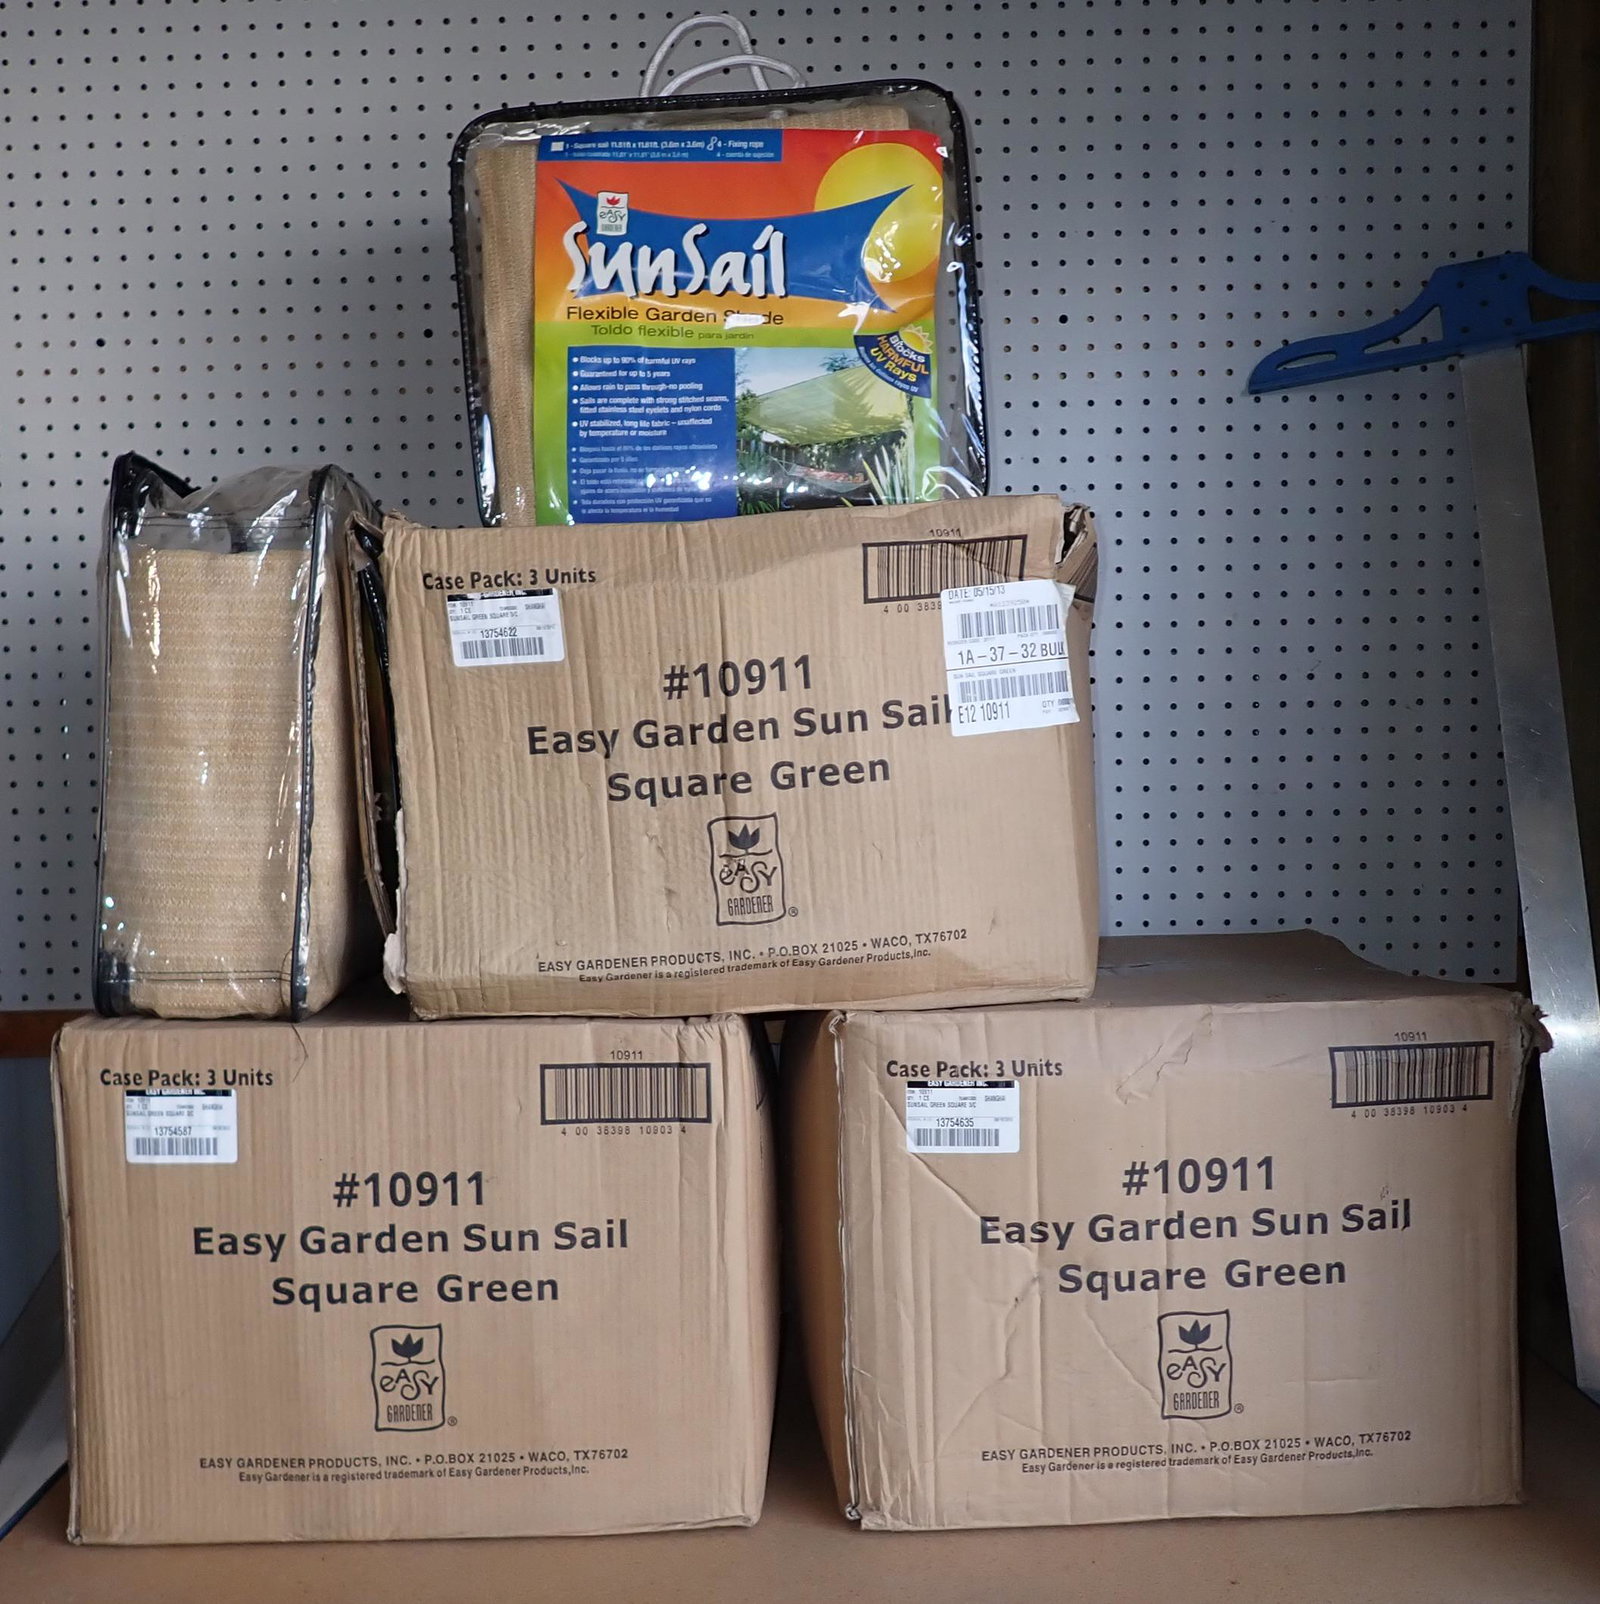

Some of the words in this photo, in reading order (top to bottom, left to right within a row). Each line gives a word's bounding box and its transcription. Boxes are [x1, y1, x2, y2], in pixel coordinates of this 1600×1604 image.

[566, 306, 639, 320] Flexible
[646, 307, 717, 323] Garden
[724, 309, 784, 325] Sde
[591, 324, 633, 336] Toldo
[638, 325, 694, 338] flexible
[877, 335, 929, 374] HARMFUL
[889, 335, 925, 363] Blocks
[870, 347, 888, 362] UV
[884, 360, 917, 382] Rays
[929, 528, 962, 538] 10911
[423, 572, 464, 590] Case
[470, 570, 523, 589] Pack:
[529, 569, 538, 586] 3
[545, 568, 596, 584] Units
[948, 590, 970, 600] DATE:
[973, 586, 1005, 597] 05/15/13
[480, 627, 518, 638] 13754622
[990, 646, 1005, 662] 37
[1021, 642, 1036, 658] 32
[663, 654, 812, 700] #10911
[958, 704, 976, 724] E12
[980, 701, 1010, 721] 10911
[527, 725, 619, 758] Easy
[634, 713, 779, 749] Garden
[794, 707, 868, 738] Sun
[882, 694, 952, 730] Sail
[607, 770, 752, 807] Square
[771, 757, 891, 790] Green
[727, 895, 773, 916] GARDENER
[538, 960, 572, 973] EASY
[577, 956, 648, 971] GARDENER
[651, 951, 725, 967] PRODUCTS,
[729, 949, 755, 961] INC.
[768, 944, 818, 958] P.O.BOX
[822, 940, 858, 953] 21025
[871, 935, 912, 949] WACO,
[916, 929, 967, 944] TX76702
[579, 974, 603, 983] Easy
[606, 971, 653, 981] Gardener
[655, 970, 663, 979] is
[674, 966, 725, 979] registered
[727, 958, 778, 970] trademark
[780, 959, 790, 967] of
[792, 958, 816, 968] Easy
[818, 955, 864, 967] Gardener
[1394, 1032, 1427, 1041] 10911
[610, 1050, 643, 1060] 10911
[100, 1069, 142, 1086] Case
[149, 1069, 199, 1086] Pack:
[208, 1069, 216, 1085] 3
[224, 1069, 273, 1086] Units
[886, 1060, 930, 1077] Case
[936, 1061, 988, 1078] Pack:
[996, 1061, 1004, 1077] 3
[1012, 1059, 1062, 1076] Units
[936, 1117, 974, 1127] 13754635
[1351, 1111, 1356, 1119] 4
[1364, 1109, 1376, 1117] 00
[1384, 1106, 1415, 1116] 38398
[1424, 1105, 1455, 1114] 10903
[1462, 1104, 1467, 1112] 4
[154, 1126, 192, 1136] 13754587
[561, 1128, 566, 1136] 4
[576, 1127, 588, 1136] 00
[597, 1126, 631, 1135] 38398
[681, 1125, 686, 1133] 4
[1122, 1155, 1274, 1196] #10911
[333, 1171, 485, 1208] #10911
[980, 1215, 1074, 1250] Easy
[1088, 1211, 1237, 1243] Garden
[1252, 1207, 1328, 1236] Sun
[1342, 1198, 1411, 1233] Sail
[193, 1226, 287, 1262] Easy
[300, 1224, 449, 1255] Garden
[464, 1223, 539, 1253] Sun
[554, 1218, 628, 1250] Sail
[1059, 1264, 1207, 1300] Square
[1225, 1259, 1346, 1288] Green
[272, 1276, 419, 1312] Square
[437, 1274, 559, 1302] Green
[1173, 1391, 1219, 1411] GARDENER
[387, 1403, 433, 1423] GARDENER
[982, 1450, 1015, 1461] EASY
[1019, 1447, 1090, 1460] GARDENER
[1171, 1443, 1197, 1454] INC.
[1210, 1439, 1260, 1452] P.O.BOX
[1265, 1438, 1301, 1449] 21025
[1314, 1436, 1355, 1448] WACO,
[1359, 1431, 1411, 1444] TX76702
[200, 1458, 232, 1469] EASY
[237, 1457, 305, 1468] GARDENER
[309, 1457, 382, 1469] PRODUCTS,
[385, 1455, 412, 1465] INC.
[424, 1453, 475, 1465] P.O.BOX
[479, 1452, 515, 1463] 21025
[528, 1451, 570, 1463] WACO,
[574, 1449, 629, 1460] TX76702
[1022, 1463, 1046, 1474] Easy
[1048, 1461, 1094, 1471] Gardener
[1097, 1461, 1105, 1470] is
[1116, 1459, 1167, 1471] registered
[1168, 1454, 1219, 1466] trademark
[1222, 1456, 1231, 1464] of
[1234, 1455, 1258, 1465] Easy
[1260, 1453, 1306, 1463] Gardener
[239, 1472, 263, 1484] Easy
[265, 1473, 310, 1482] Gardener
[312, 1473, 320, 1482] is
[322, 1474, 329, 1482] a
[331, 1472, 382, 1484] registered
[384, 1468, 434, 1479] trademark
[437, 1468, 446, 1477] of
[449, 1467, 473, 1478] Easy
[475, 1466, 521, 1477] Gardener
